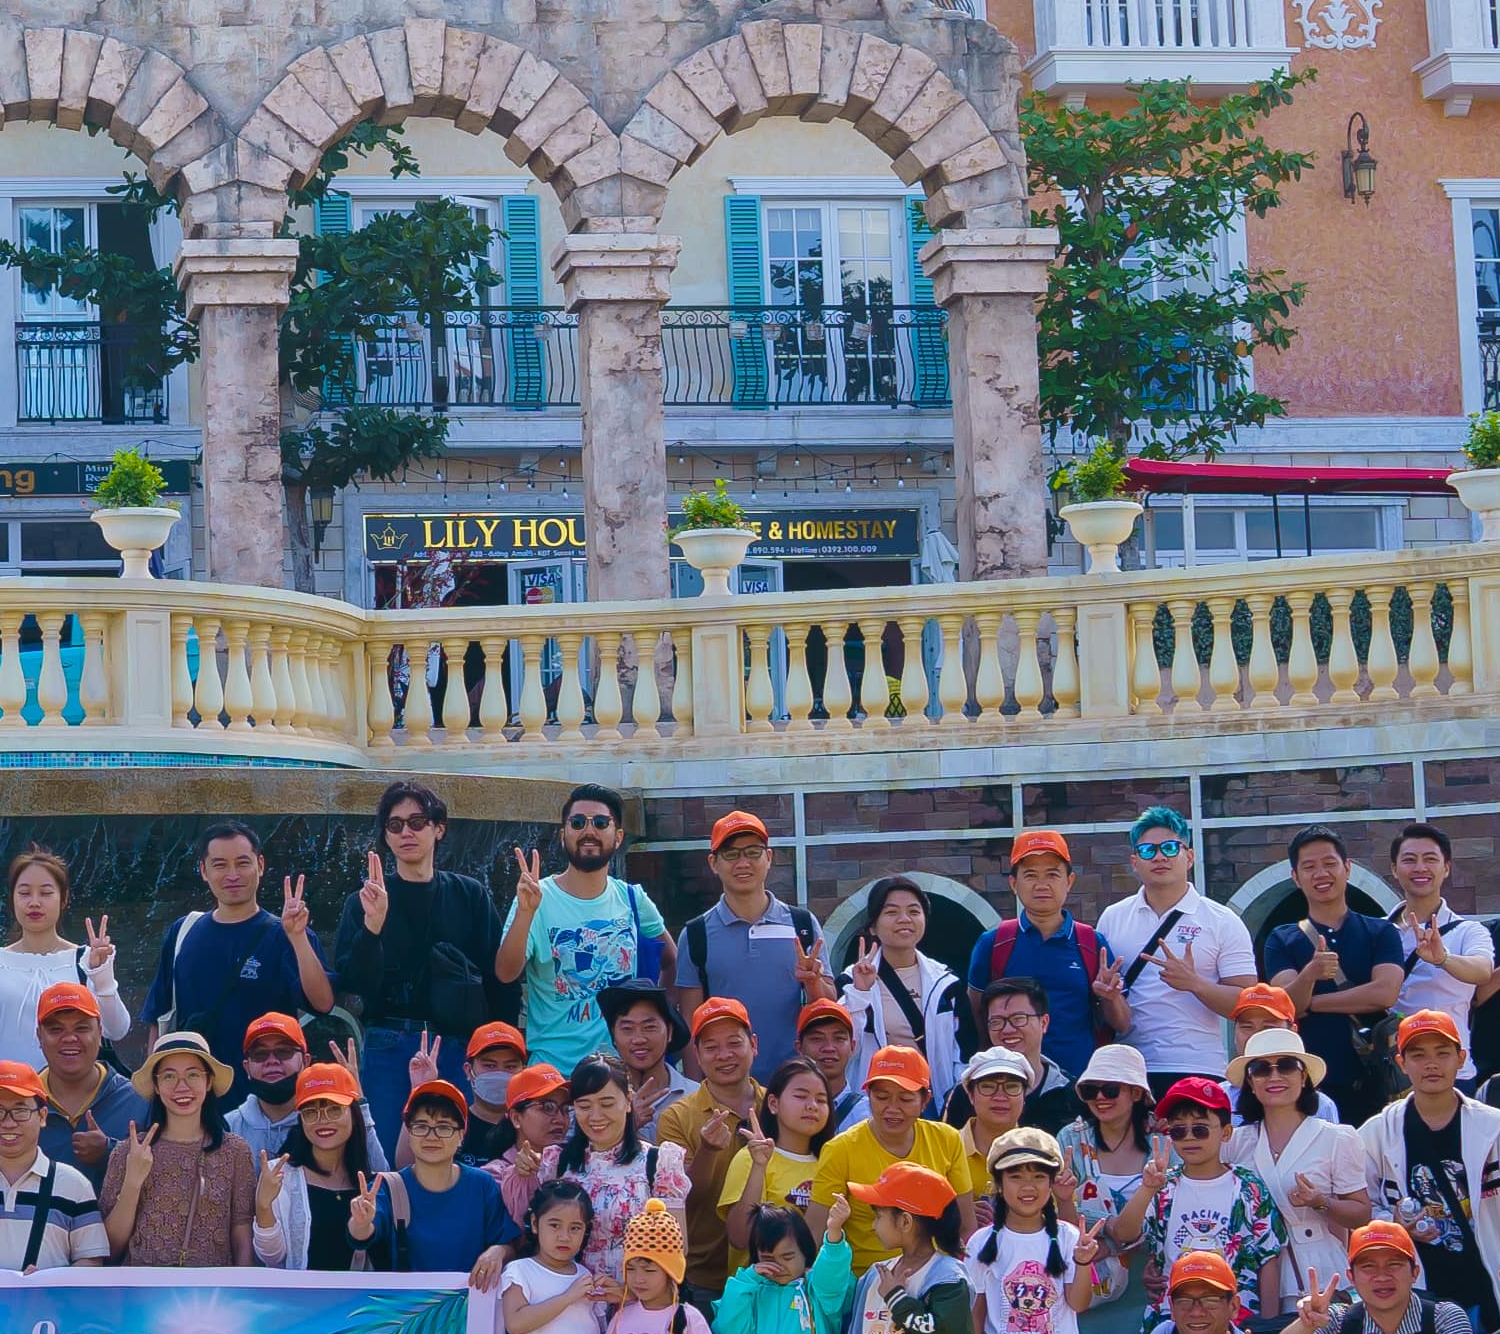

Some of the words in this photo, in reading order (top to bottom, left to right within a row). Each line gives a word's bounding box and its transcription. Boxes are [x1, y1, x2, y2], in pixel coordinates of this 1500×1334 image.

[423, 518, 501, 549] LILY
[512, 518, 587, 548] HOU
[768, 520, 783, 540] &
[788, 519, 897, 540] HOMESTAY
[745, 581, 768, 594] VISA
[1180, 1209, 1229, 1225] RACING
